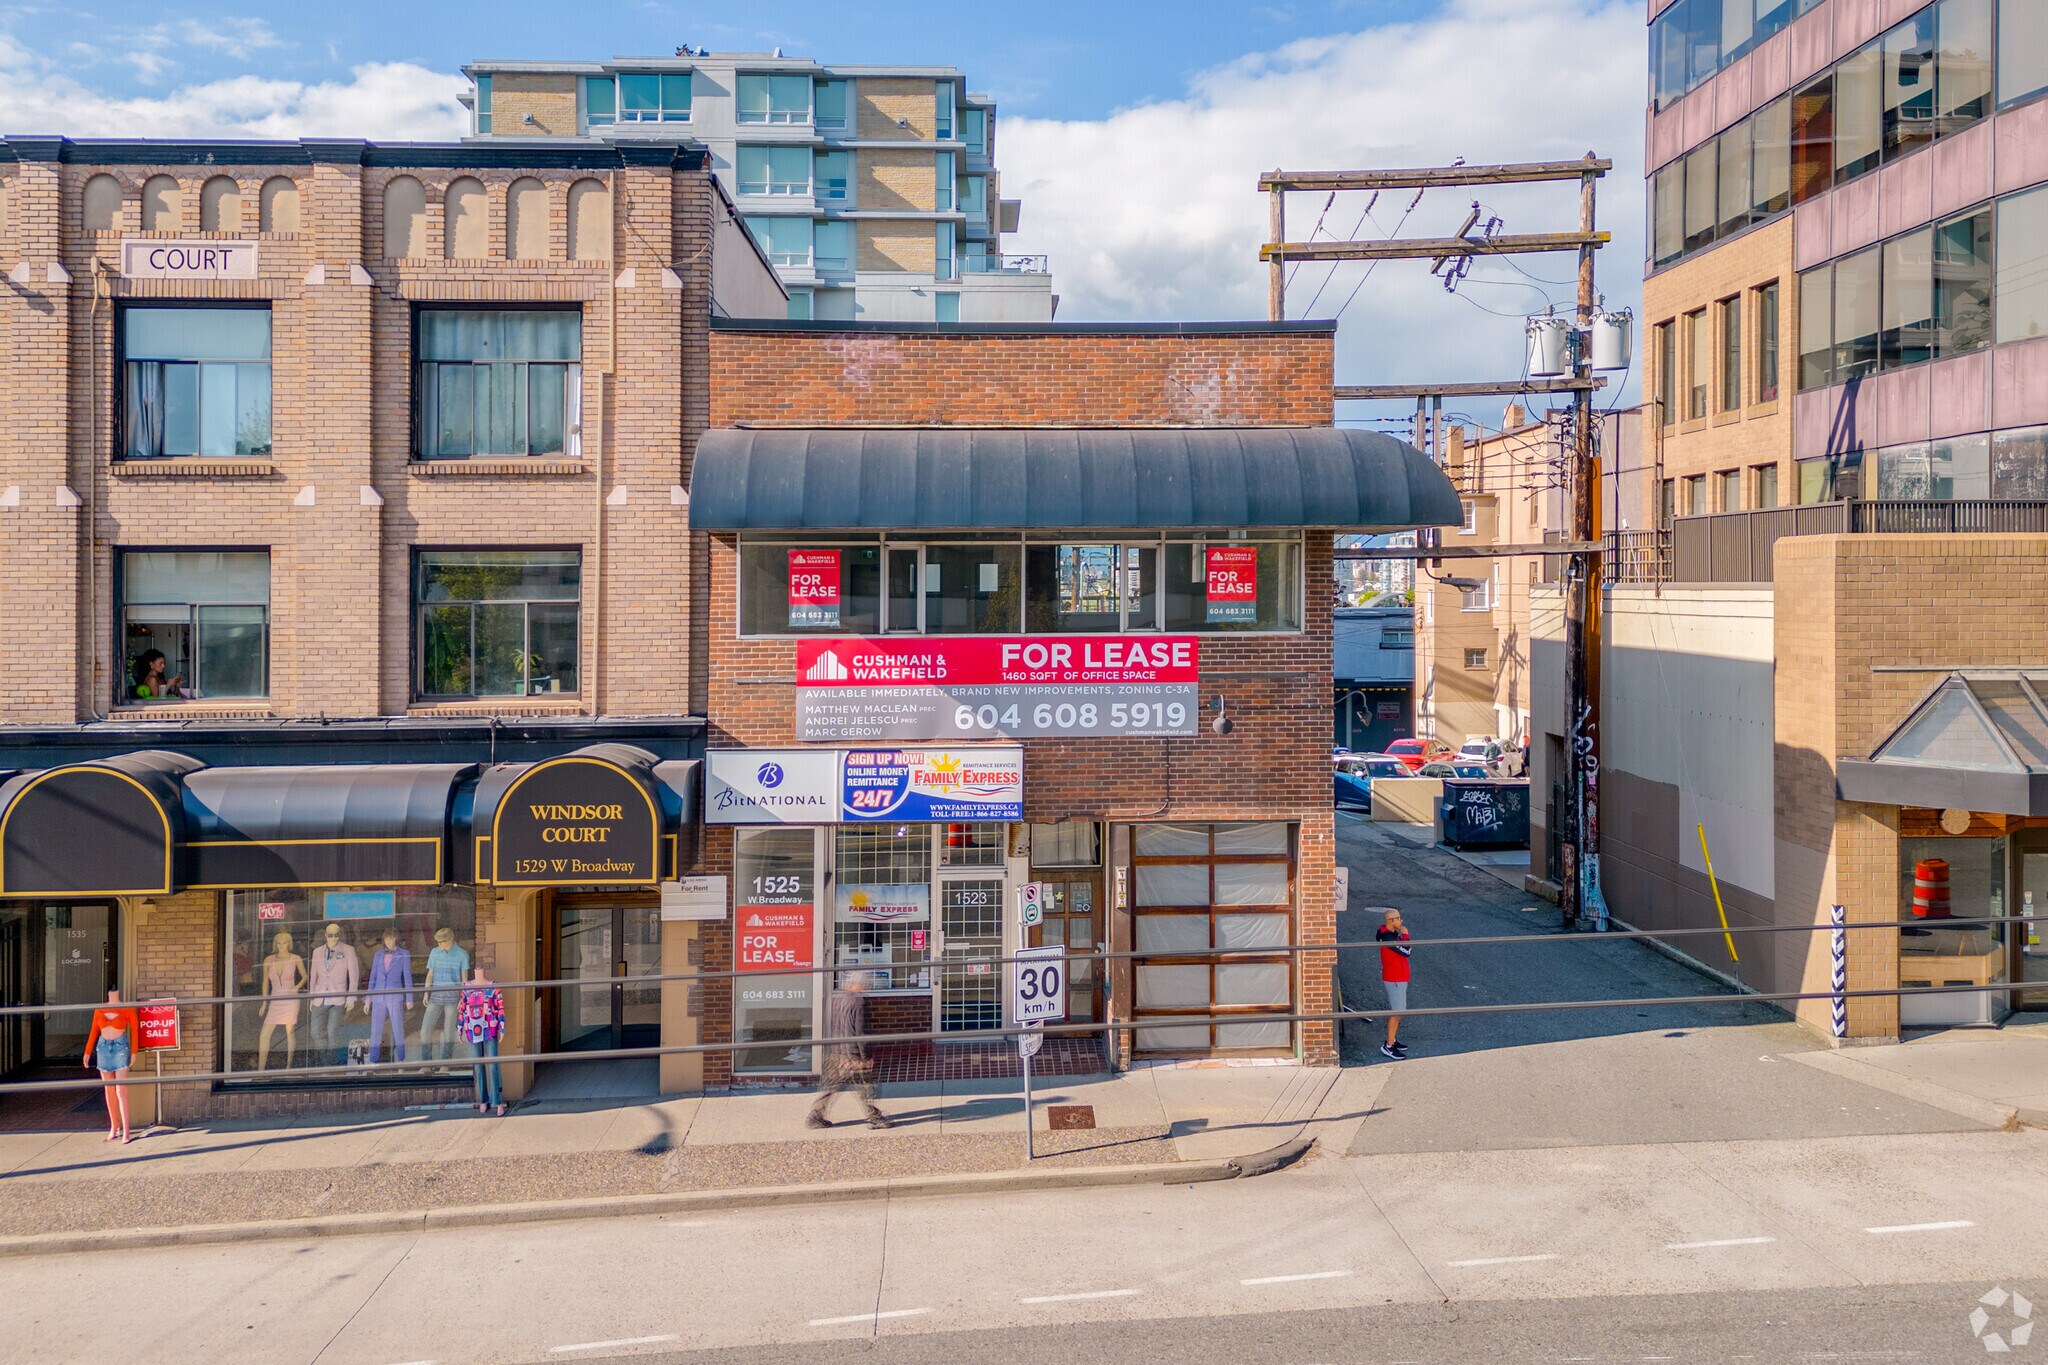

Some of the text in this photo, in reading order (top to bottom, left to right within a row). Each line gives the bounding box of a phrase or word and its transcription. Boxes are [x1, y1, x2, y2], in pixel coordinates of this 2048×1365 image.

[149, 248, 232, 270] COURT
[792, 574, 821, 586] FOR
[1209, 571, 1238, 582] FOR
[792, 586, 837, 597] LEASE
[1209, 582, 1252, 594] LEASE
[852, 654, 946, 666] CUSHMAN &
[1002, 642, 1192, 669] FOR LEASE
[852, 668, 947, 680] WAKEFIELD
[1002, 671, 1156, 681] 1460 SQFT OF OFFICE SPACE
[805, 686, 1190, 698] AVAILABLE IMMEDIATELY, BRAND NEW IMPROVEMENTS, ZONING C-3A
[805, 705, 860, 714] MATTHEW
[864, 704, 918, 713] MACLEAN
[805, 716, 848, 726] ANDREI
[851, 716, 898, 725] JELESCU
[954, 702, 1186, 730] 604 608 5919
[805, 728, 882, 736] MARC GEROW
[848, 752, 924, 766] SIGN UP NOW!
[847, 768, 908, 776] ONLINE MONEY
[847, 778, 898, 786] REMITTANCE
[714, 787, 826, 810] BitNATIONAL
[852, 790, 894, 808] 24/7
[530, 804, 624, 820] WINDSOR
[542, 827, 610, 843] COURT
[515, 858, 636, 875] 1529 W Broadway
[752, 876, 800, 894] 1525
[748, 896, 803, 906] W.Broadway
[955, 892, 988, 906] 1523
[67, 930, 87, 938] 1535
[743, 936, 777, 948] FOR
[743, 950, 795, 962] LEASE
[1020, 966, 1060, 1000] 30
[742, 990, 805, 999] 604 683 3111
[1024, 1001, 1055, 1014] km/h
[140, 1020, 175, 1028] POP-UP
[146, 1029, 169, 1038] SALE
